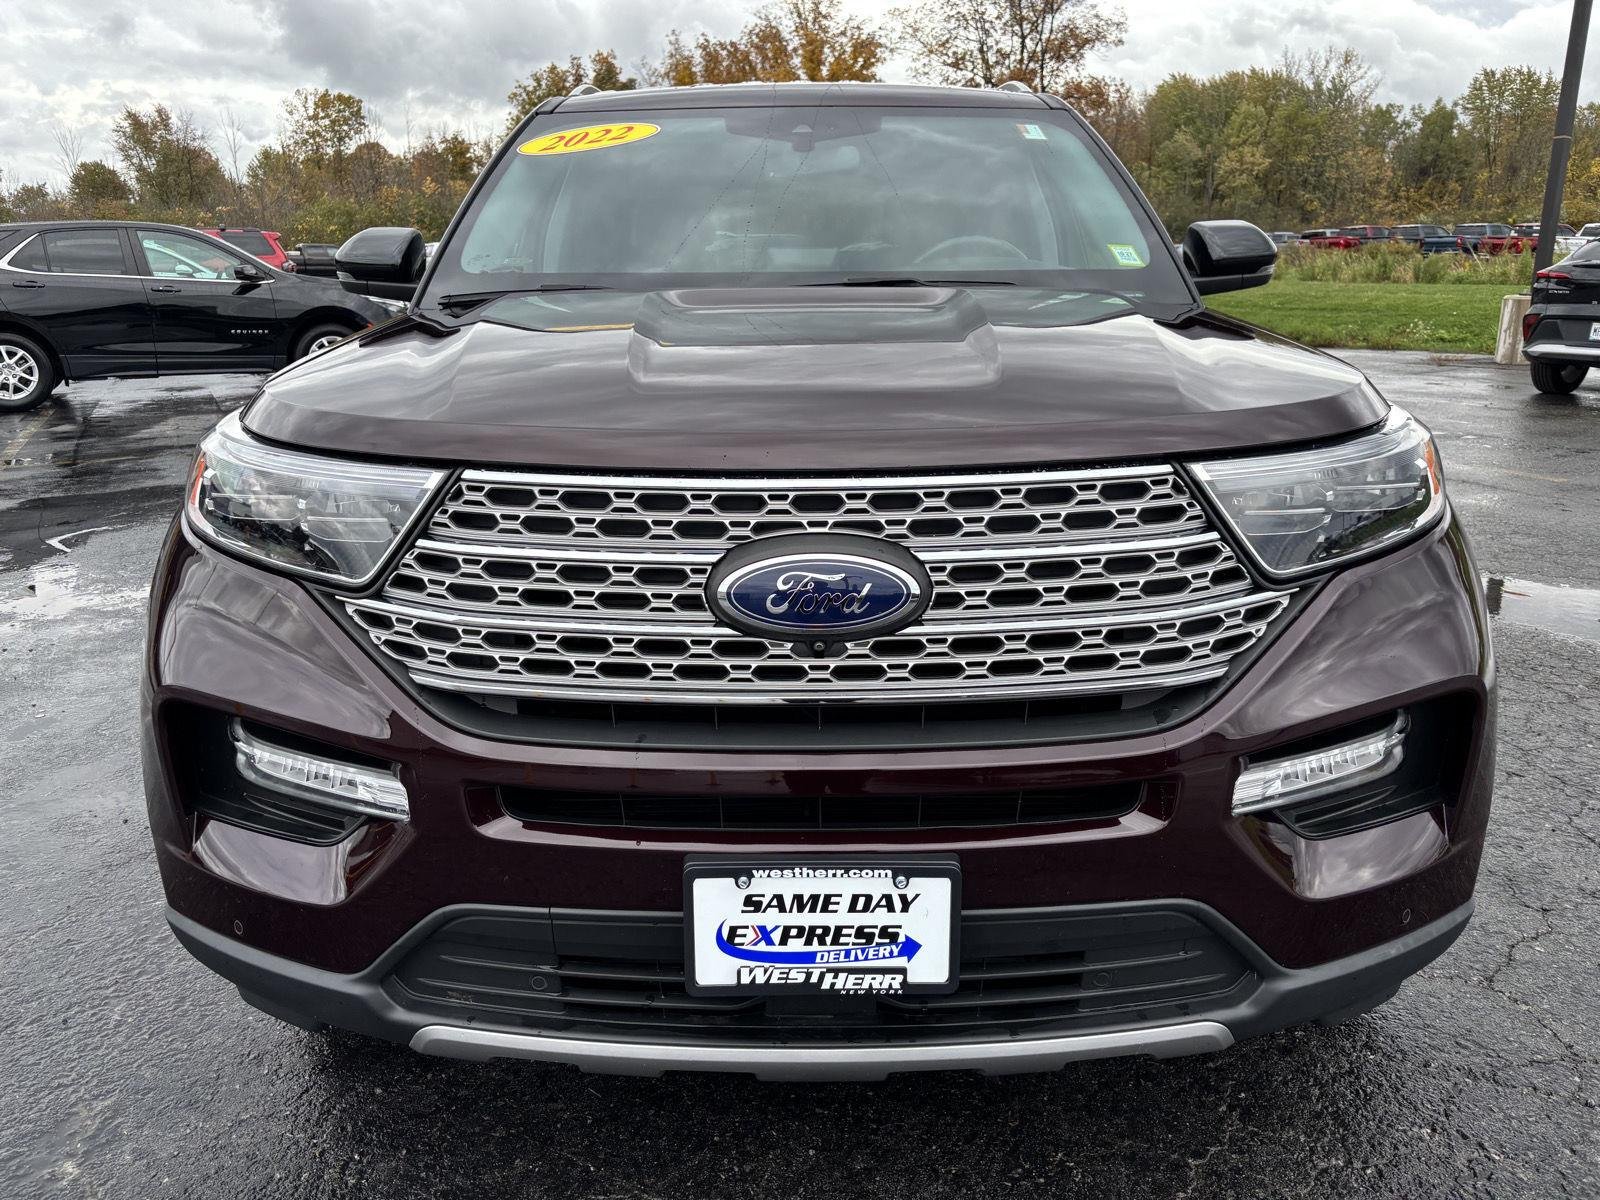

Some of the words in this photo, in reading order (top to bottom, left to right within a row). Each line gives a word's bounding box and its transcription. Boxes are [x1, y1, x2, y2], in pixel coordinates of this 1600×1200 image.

[537, 126, 635, 152] 2022
[766, 571, 873, 614] Ford
[752, 867, 893, 879] westherr.com
[740, 893, 843, 914] SAME
[846, 893, 921, 914] DAY
[725, 924, 903, 947] EXPRESS
[814, 942, 903, 964] DELIVERY
